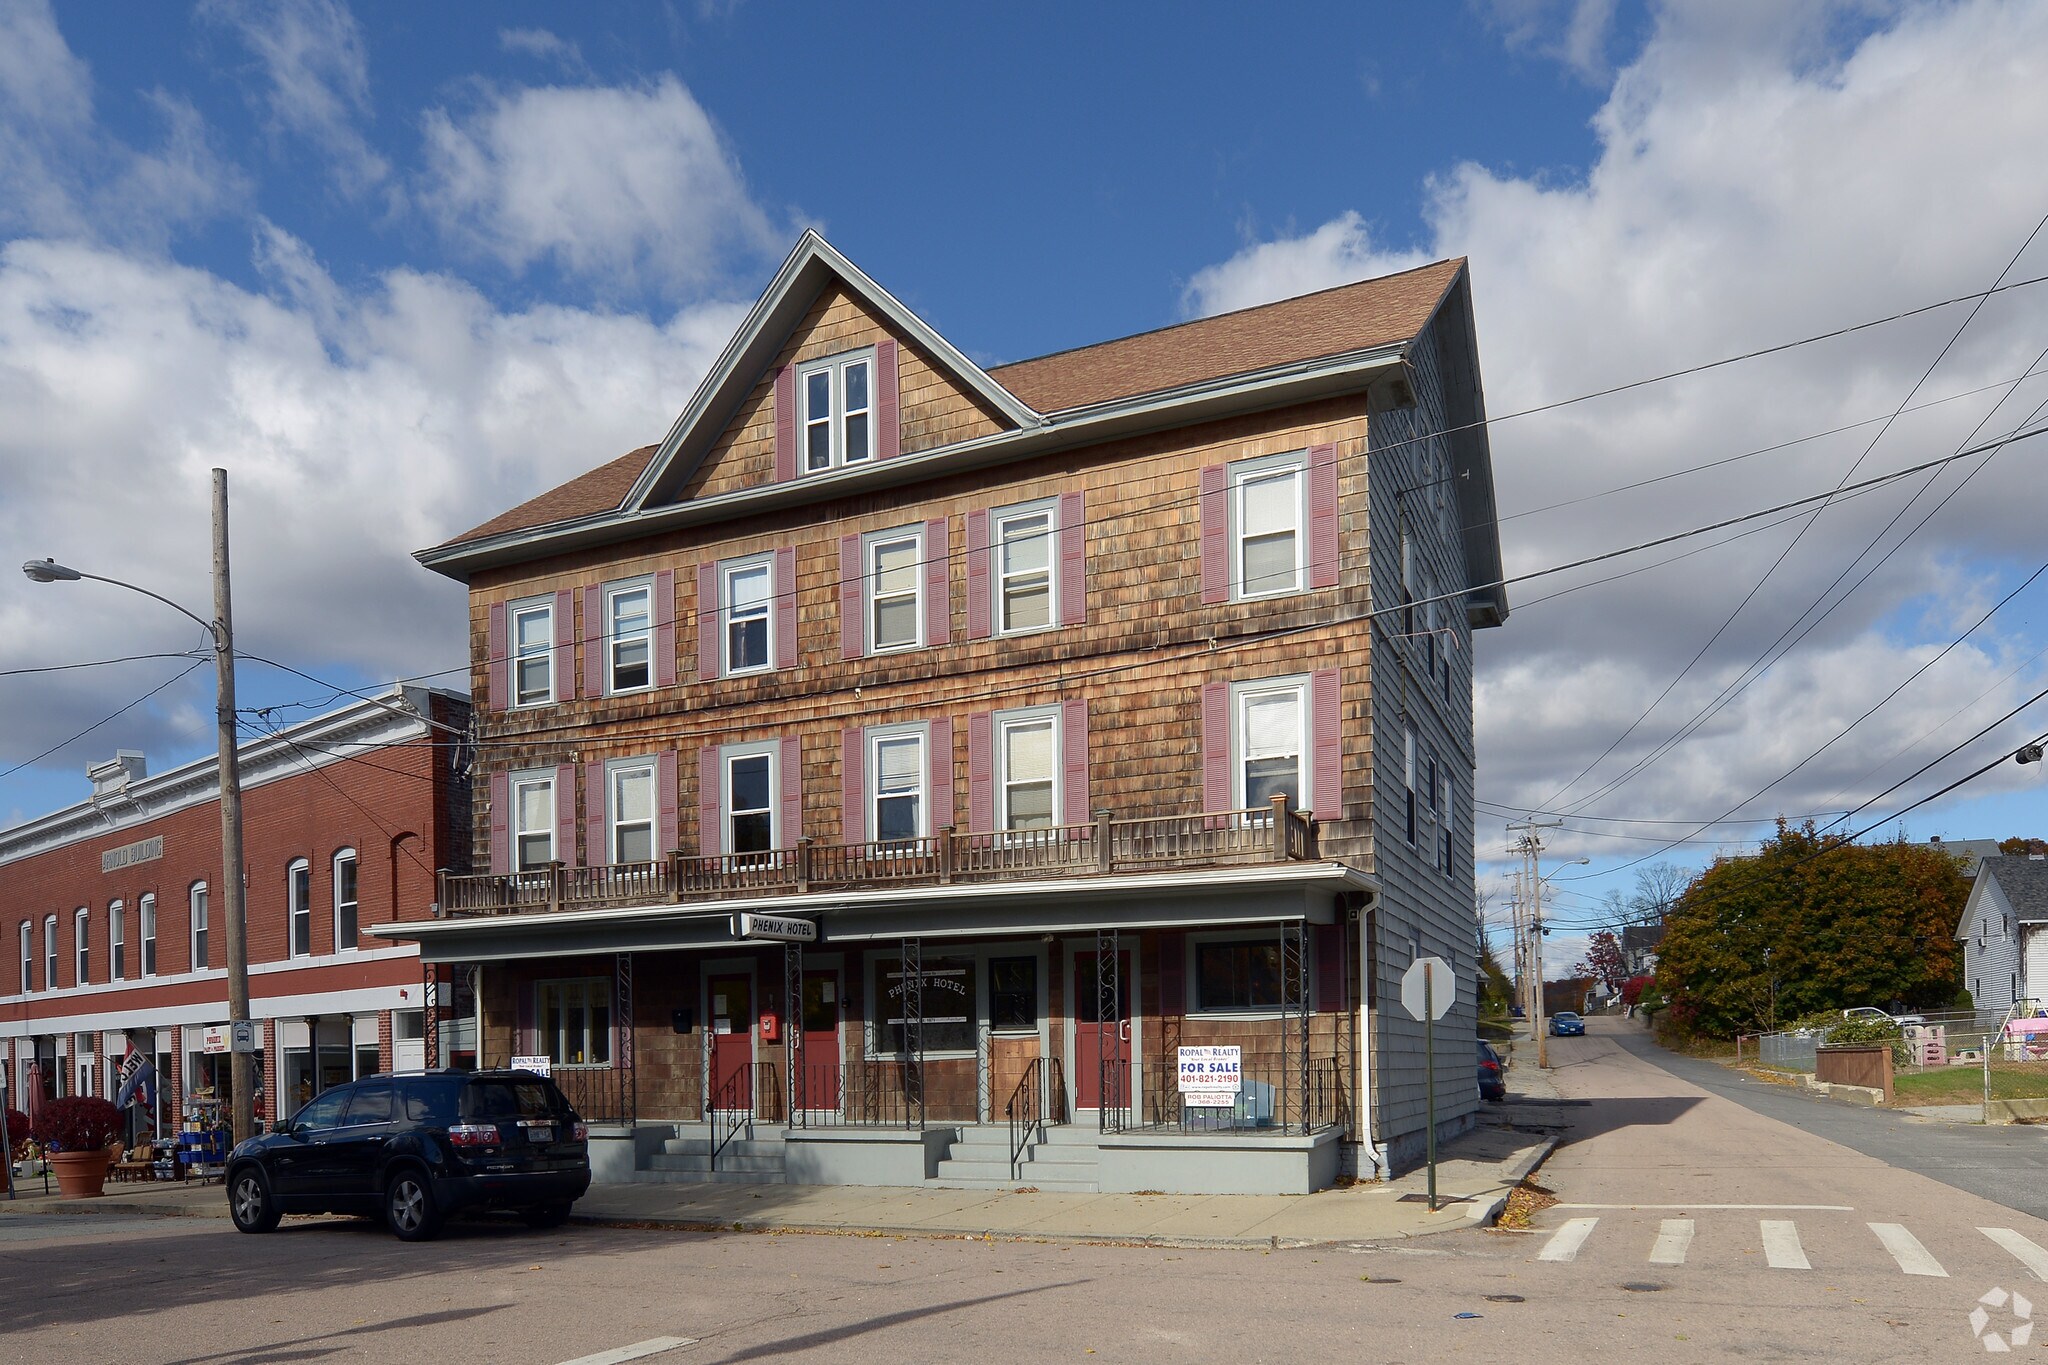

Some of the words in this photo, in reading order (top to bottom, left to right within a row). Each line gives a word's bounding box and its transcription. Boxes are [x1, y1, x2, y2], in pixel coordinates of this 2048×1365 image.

[103, 849, 127, 869] ARNOLD
[131, 840, 161, 862] BUILDING
[752, 919, 783, 933] PHENIX
[787, 922, 811, 935] HOTEL
[933, 978, 966, 996] HOTEL
[1180, 1048, 1203, 1056] ROPAL
[1213, 1048, 1239, 1056] REALTY
[1181, 1063, 1204, 1072] FOR
[1209, 1063, 1238, 1072] SALE
